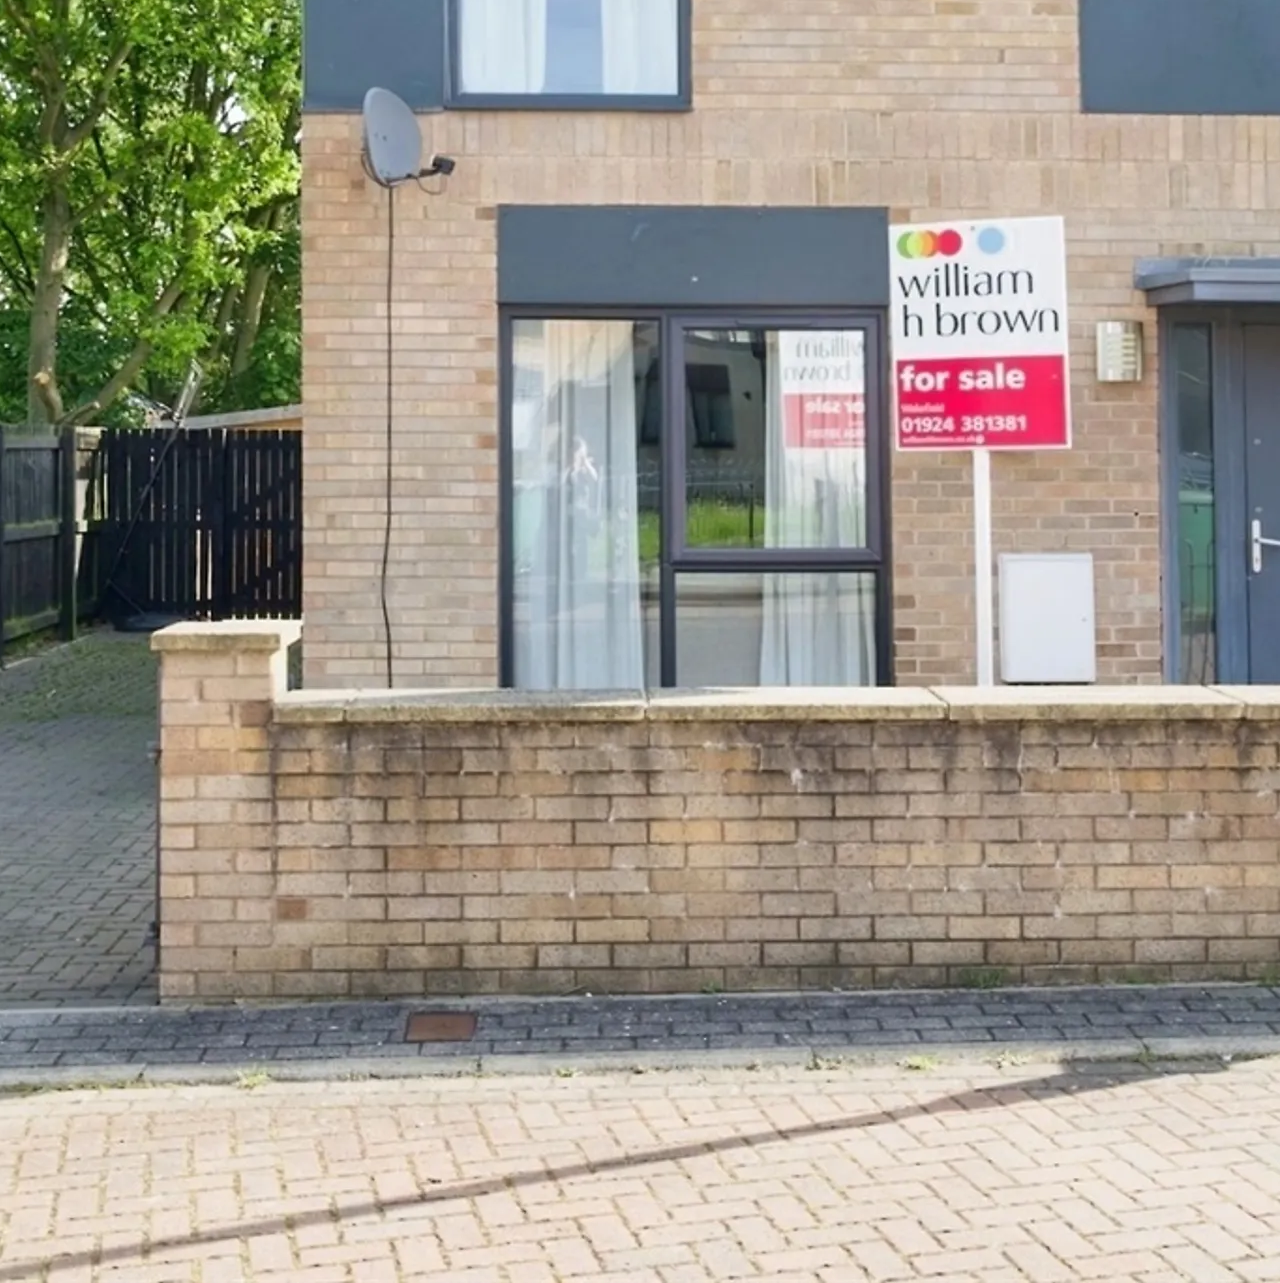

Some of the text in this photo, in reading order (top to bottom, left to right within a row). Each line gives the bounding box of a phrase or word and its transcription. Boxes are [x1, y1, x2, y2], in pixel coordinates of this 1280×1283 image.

[898, 263, 1034, 298] william
[903, 302, 1060, 337] h brown
[900, 362, 1026, 392] for sale
[901, 415, 1027, 433] 01924 381381
